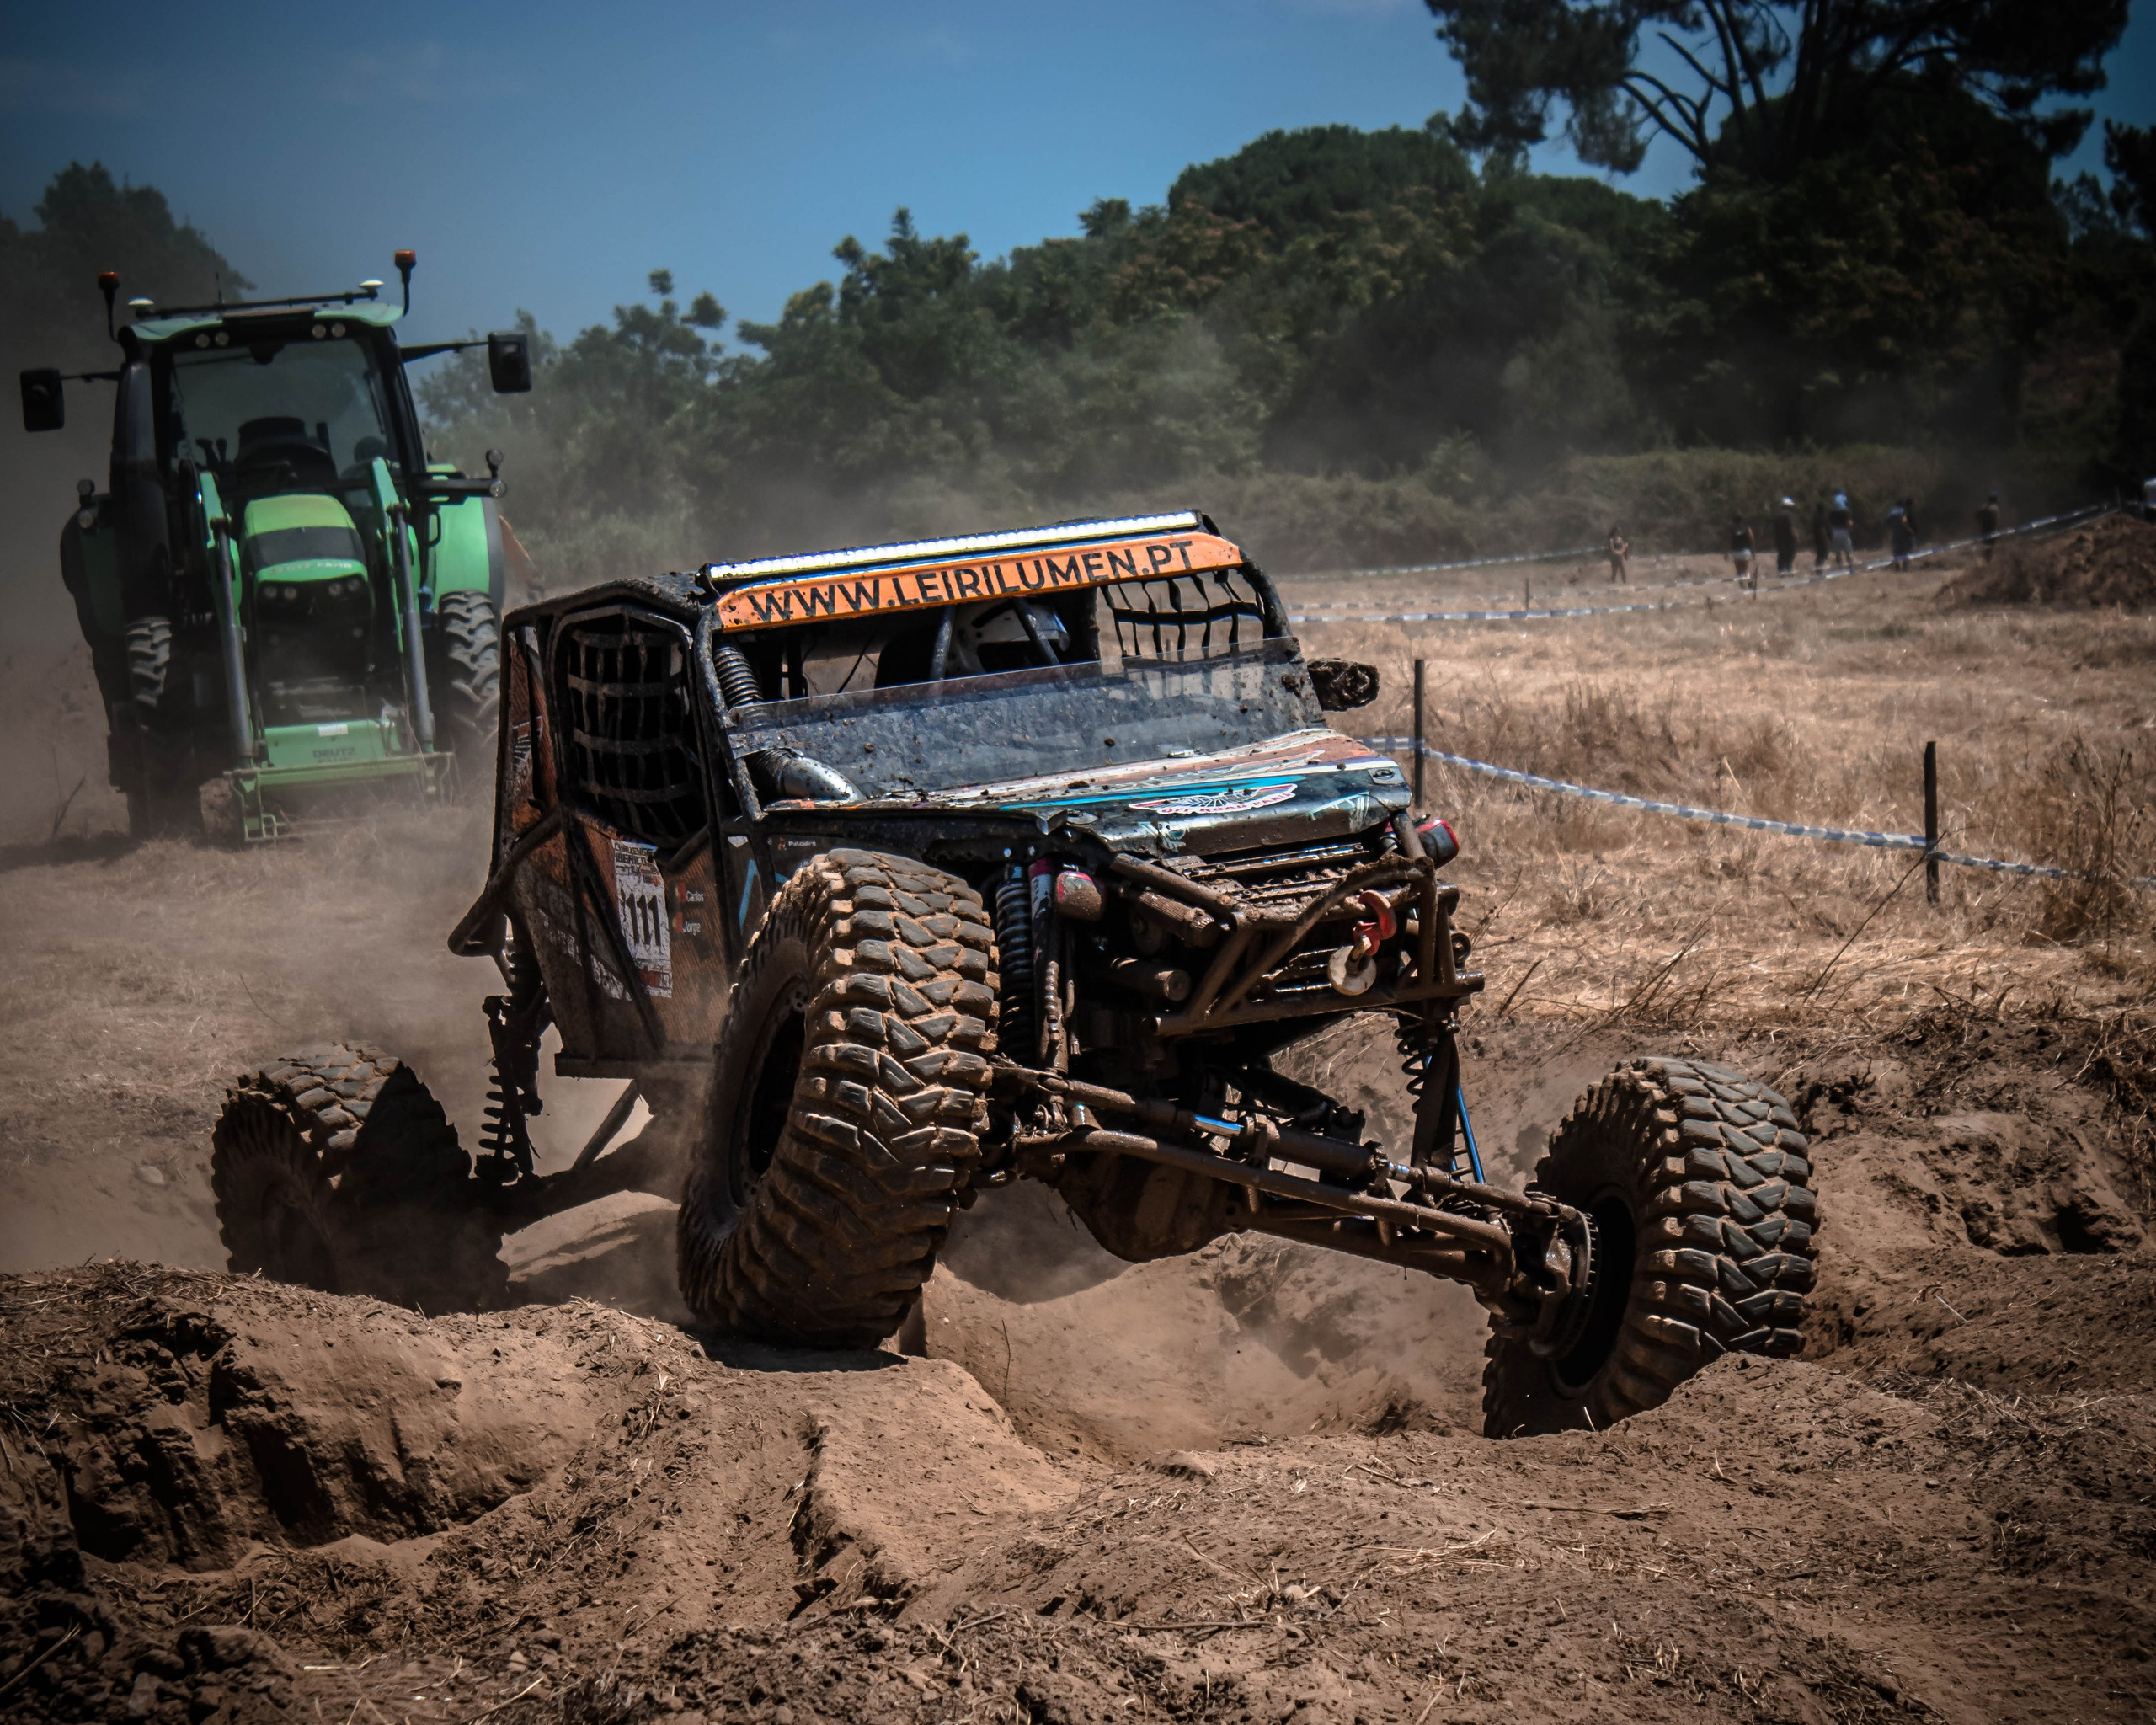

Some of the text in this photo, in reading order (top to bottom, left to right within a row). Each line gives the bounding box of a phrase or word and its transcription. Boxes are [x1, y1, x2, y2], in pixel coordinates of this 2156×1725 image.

[745, 540, 1193, 623] WWW.LEIRILUMEN.PT
[1199, 804, 1247, 813] ROAD
[1252, 793, 1292, 808] PARTS
[686, 889, 704, 902] Carlos
[625, 893, 662, 948] 111
[682, 921, 701, 936] Jorge
